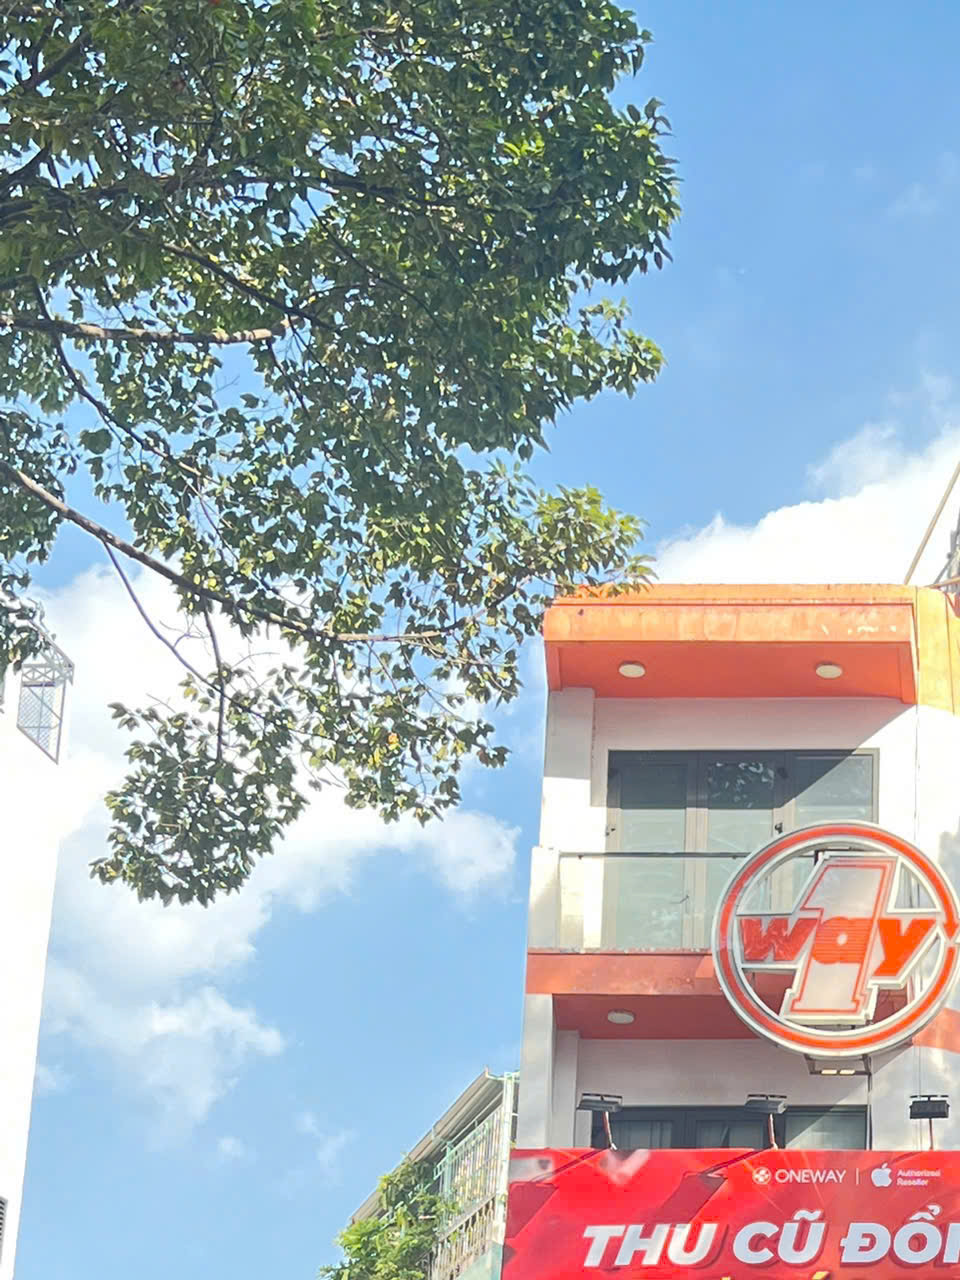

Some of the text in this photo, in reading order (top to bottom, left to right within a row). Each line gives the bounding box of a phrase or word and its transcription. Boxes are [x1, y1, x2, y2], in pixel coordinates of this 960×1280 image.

[775, 1169, 846, 1183] ONEWAY
[583, 1224, 717, 1267] THU
[733, 1211, 826, 1267] CŨ
